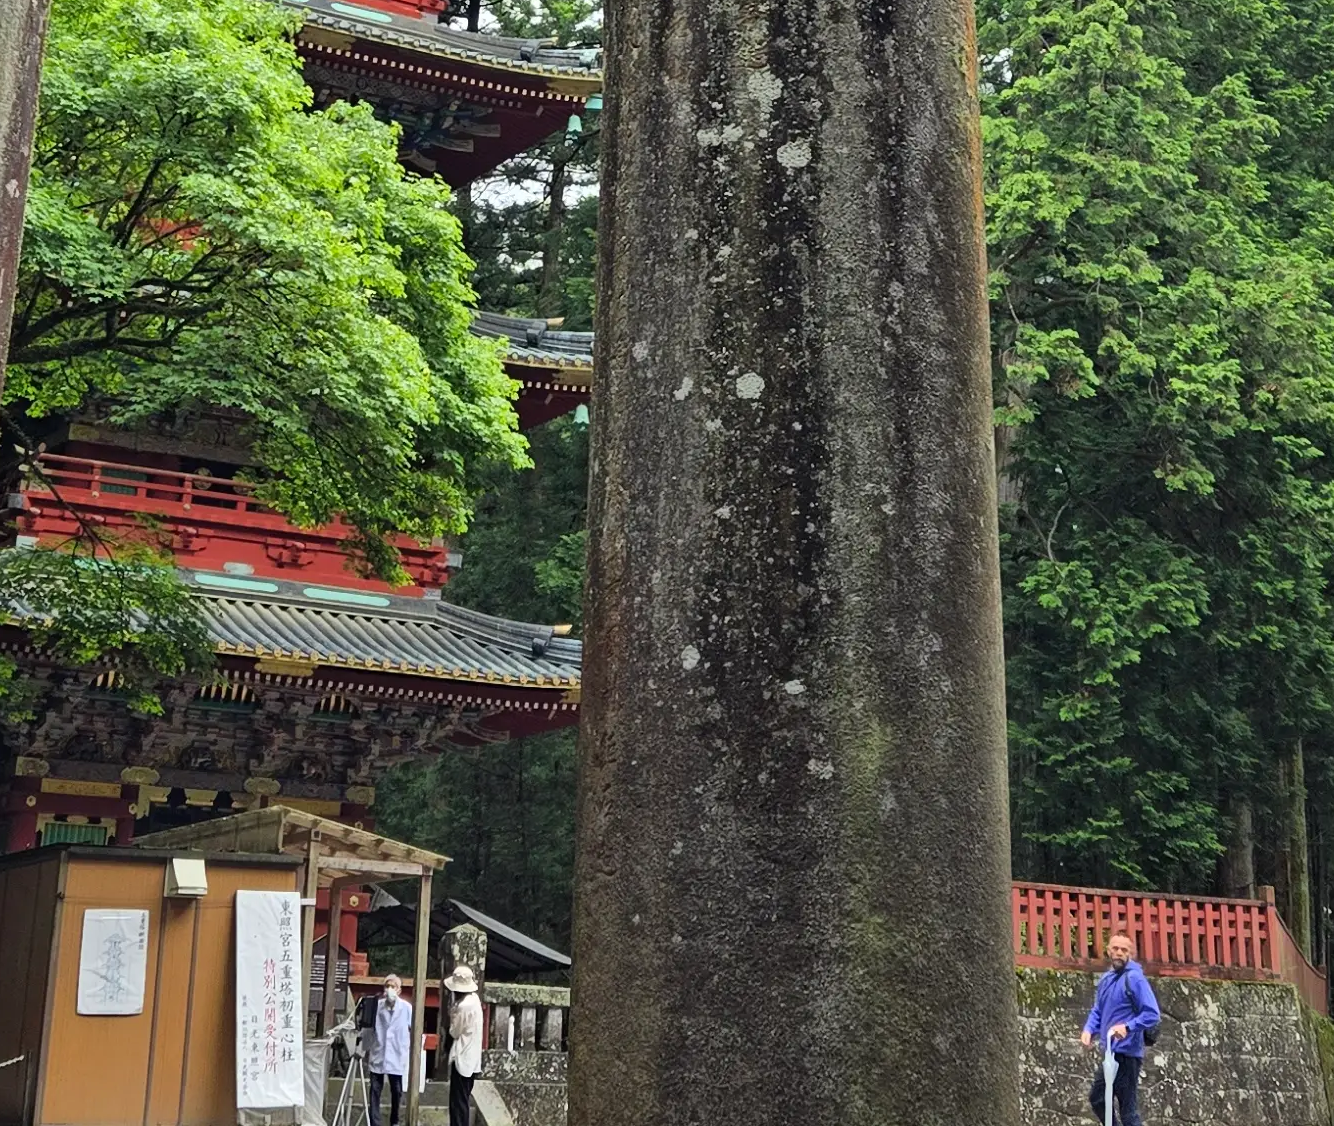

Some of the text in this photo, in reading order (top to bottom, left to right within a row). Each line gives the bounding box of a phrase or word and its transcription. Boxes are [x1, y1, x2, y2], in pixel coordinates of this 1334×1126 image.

[263, 958, 278, 1074] 特別公開受付所
